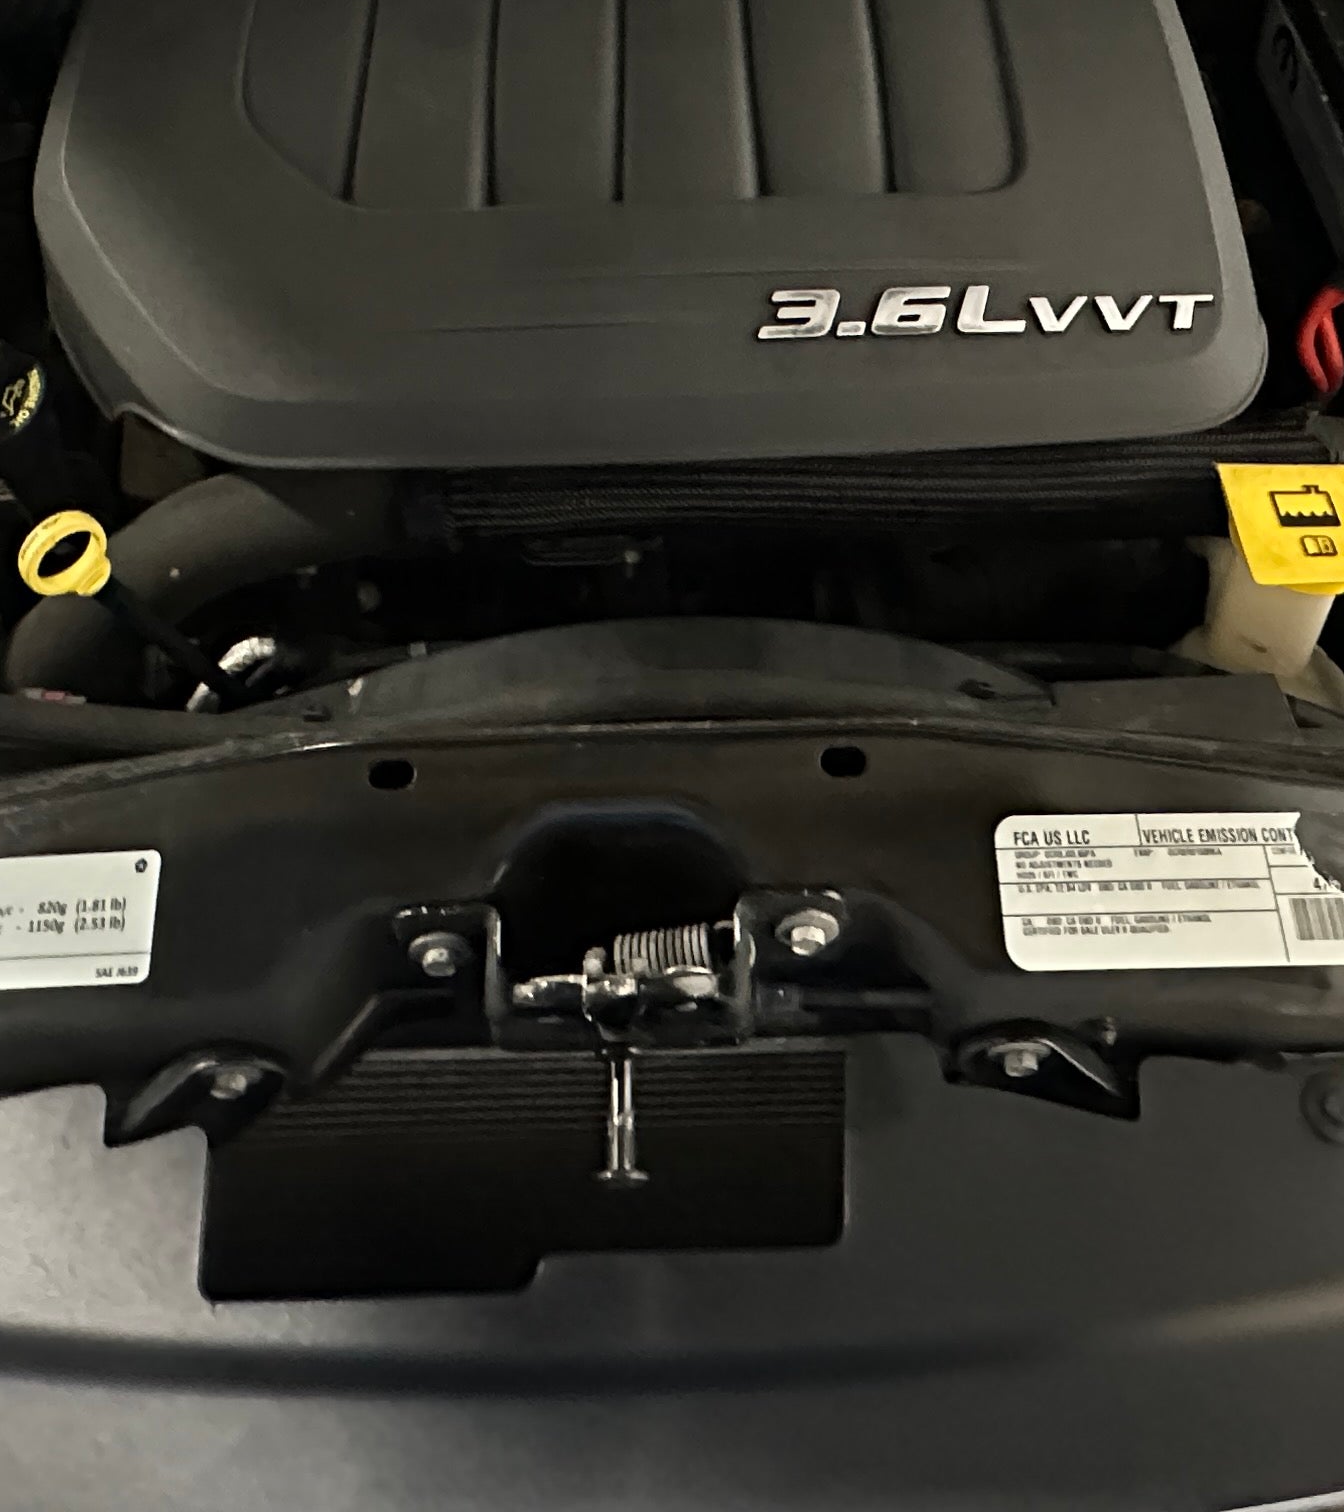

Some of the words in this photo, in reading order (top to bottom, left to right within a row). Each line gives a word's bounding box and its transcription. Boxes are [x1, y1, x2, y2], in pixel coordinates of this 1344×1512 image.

[1014, 830, 1039, 846] FCA
[1044, 830, 1062, 845] US
[1067, 829, 1090, 845] LLC
[1142, 828, 1194, 844] VEHICLE
[1197, 827, 1257, 843] EMISSION
